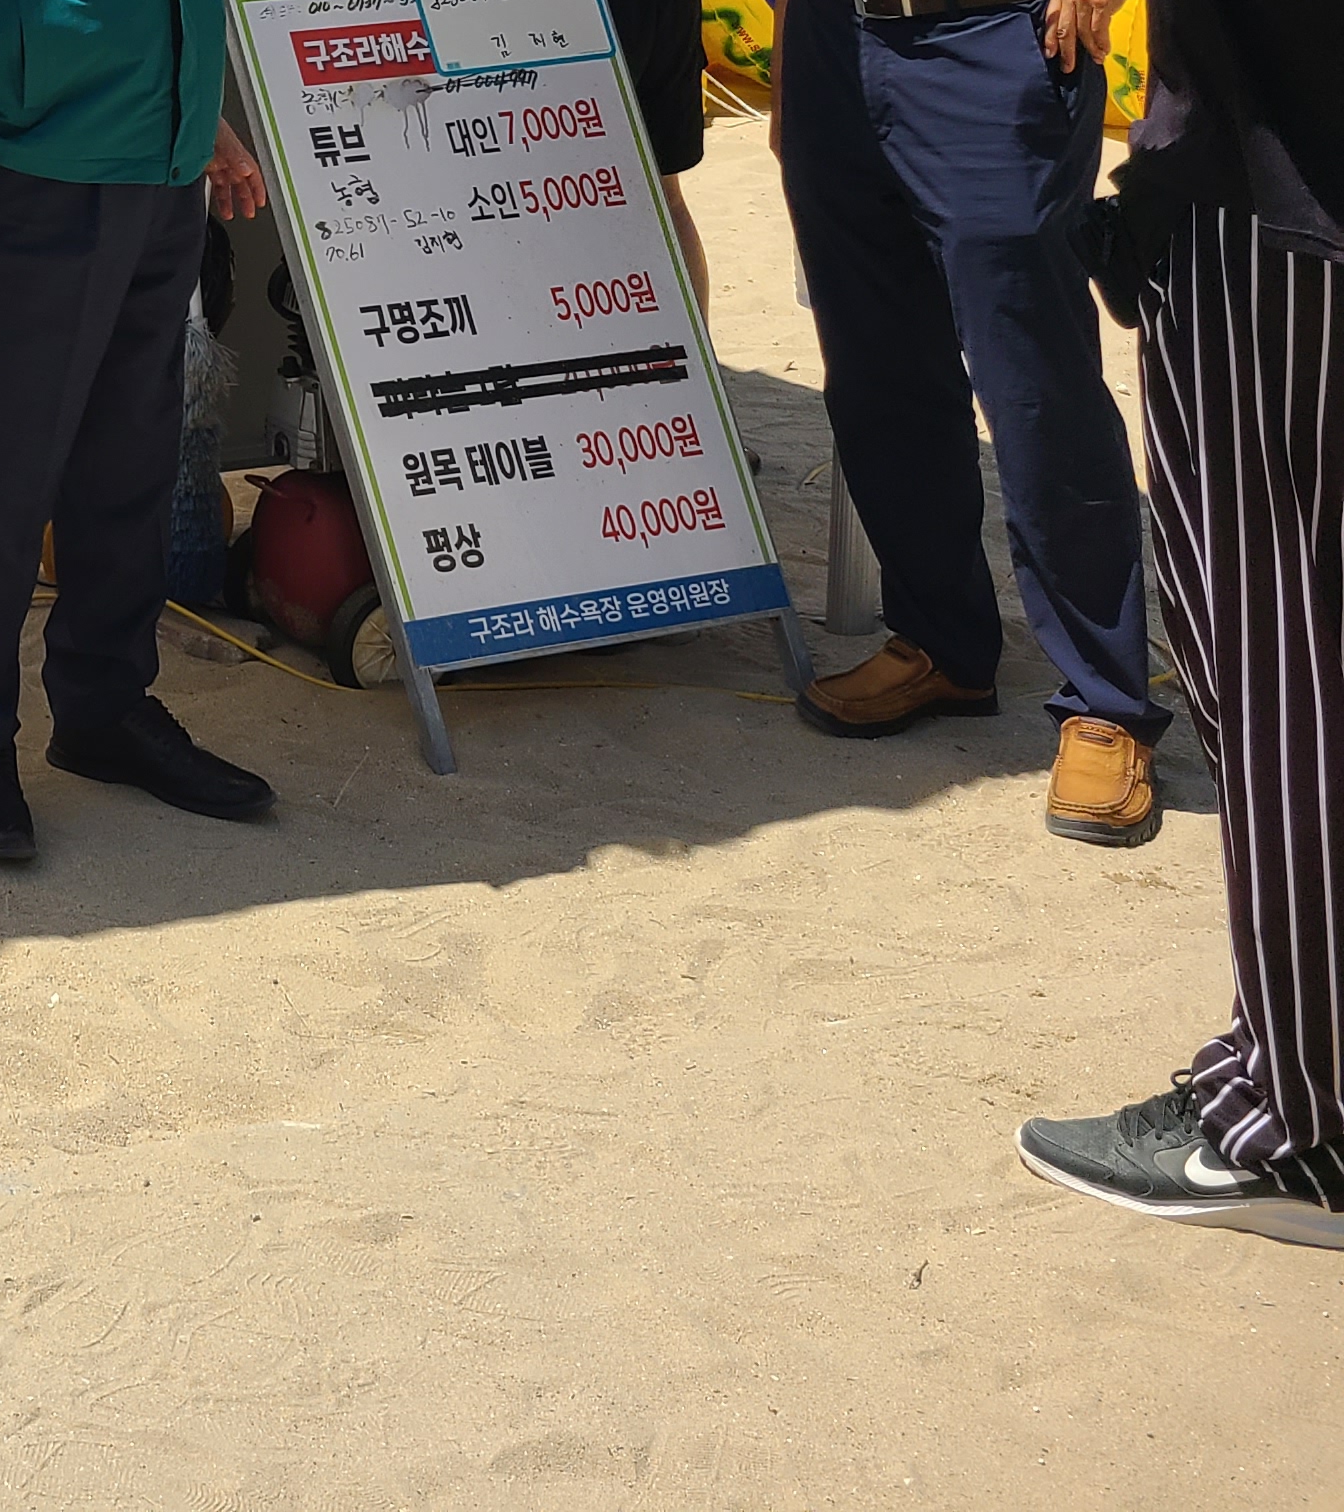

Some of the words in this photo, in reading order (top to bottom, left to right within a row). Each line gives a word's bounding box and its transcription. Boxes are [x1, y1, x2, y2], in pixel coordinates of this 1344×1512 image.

[302, 30, 431, 72] 구조라해수
[308, 122, 372, 169] 튜브
[445, 115, 502, 159] 대인
[498, 97, 608, 152] 7,000원
[466, 181, 522, 225] 소인
[518, 165, 628, 223] 5,000원
[358, 293, 479, 348] 구명조끼
[549, 270, 661, 329] 5,000원
[402, 448, 464, 498] 원목
[466, 434, 557, 488] 테이블
[575, 413, 705, 475] 30,000원
[422, 522, 486, 574] 평상
[600, 486, 727, 549] 40,000원
[467, 608, 535, 645] 구조라
[535, 592, 624, 635] 해수욕장
[624, 577, 733, 617] 운영위원장
